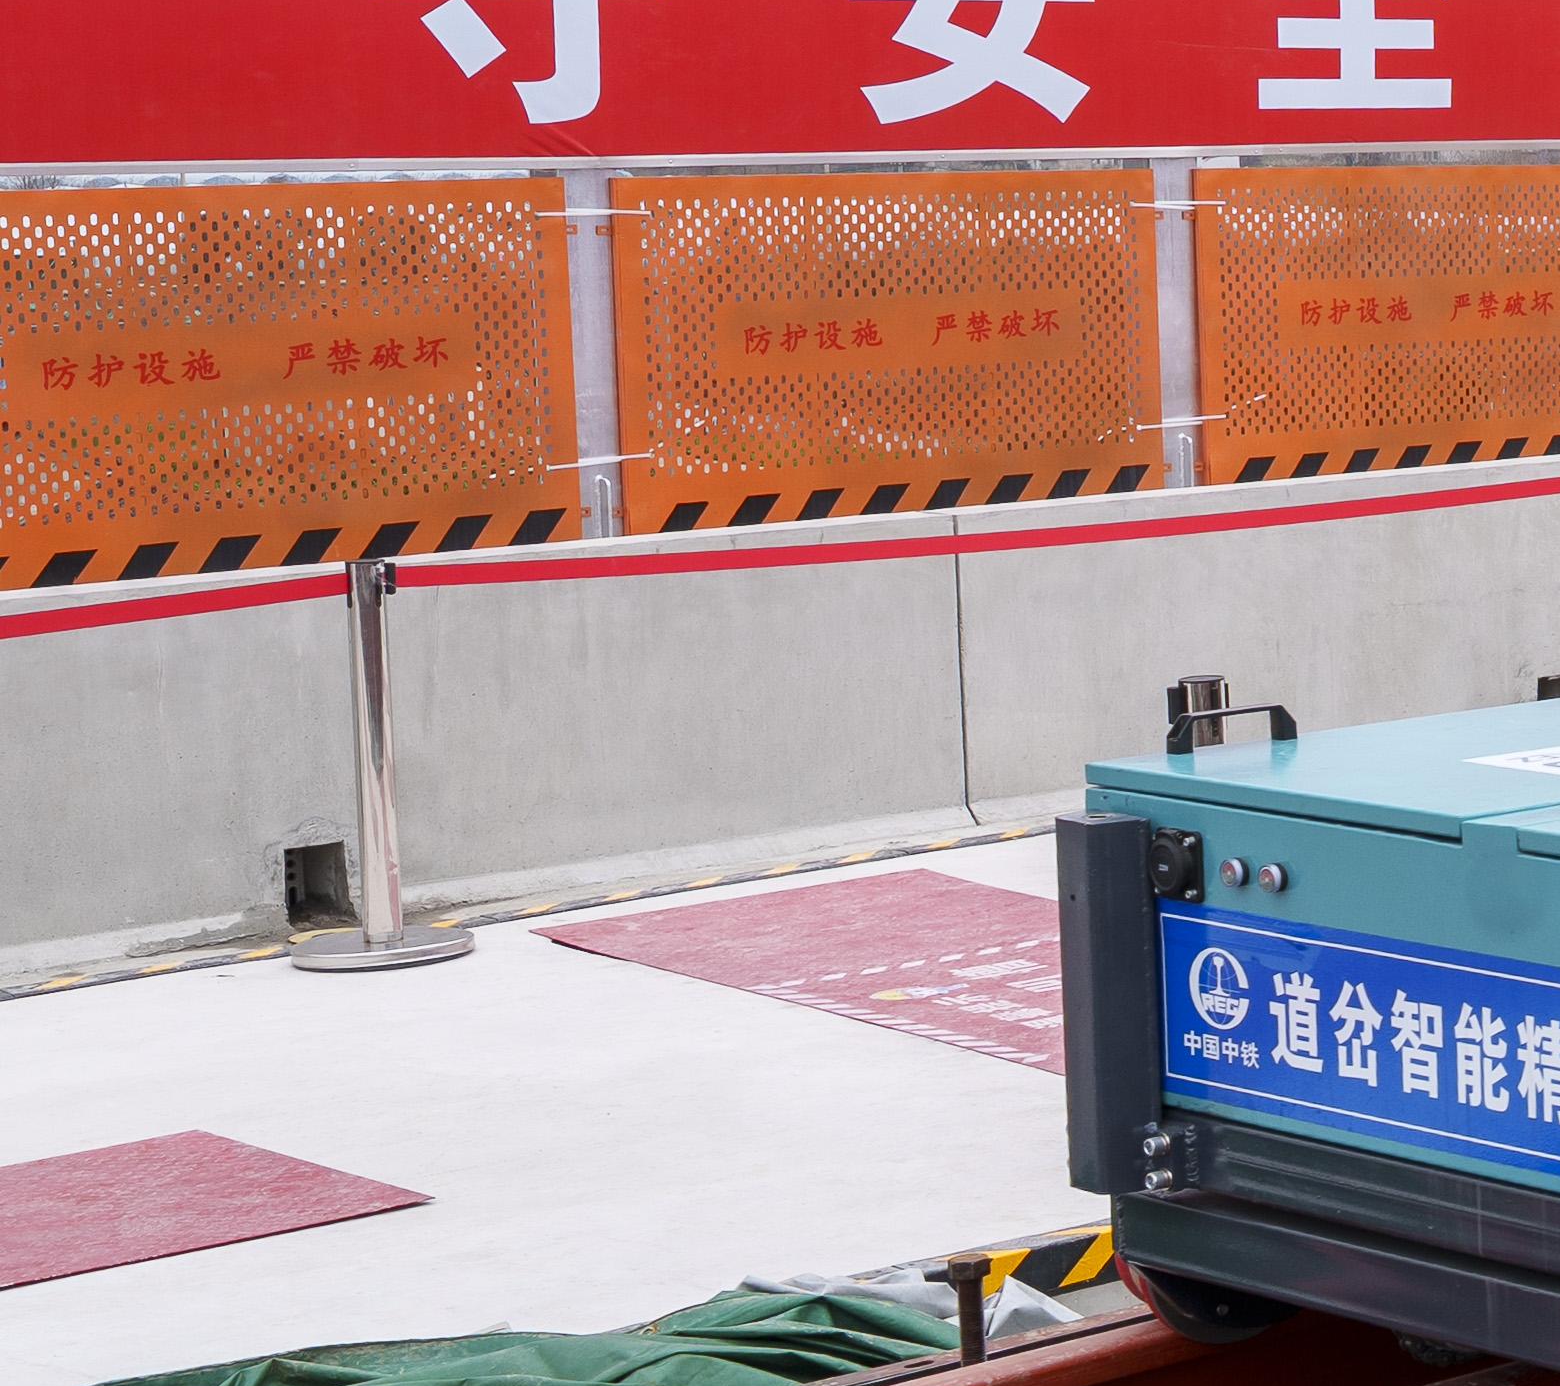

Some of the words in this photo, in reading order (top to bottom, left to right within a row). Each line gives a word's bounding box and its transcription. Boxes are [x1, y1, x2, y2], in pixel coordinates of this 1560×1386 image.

[1300, 295, 1412, 326] 防护设施
[1451, 290, 1554, 320] 严禁破坏
[744, 317, 883, 356] 防护设施
[932, 307, 1060, 345] 严禁破坏
[42, 347, 221, 391] 防护设施
[284, 335, 449, 379] 严禁破坏
[1183, 1029, 1260, 1070] 中国中铁
